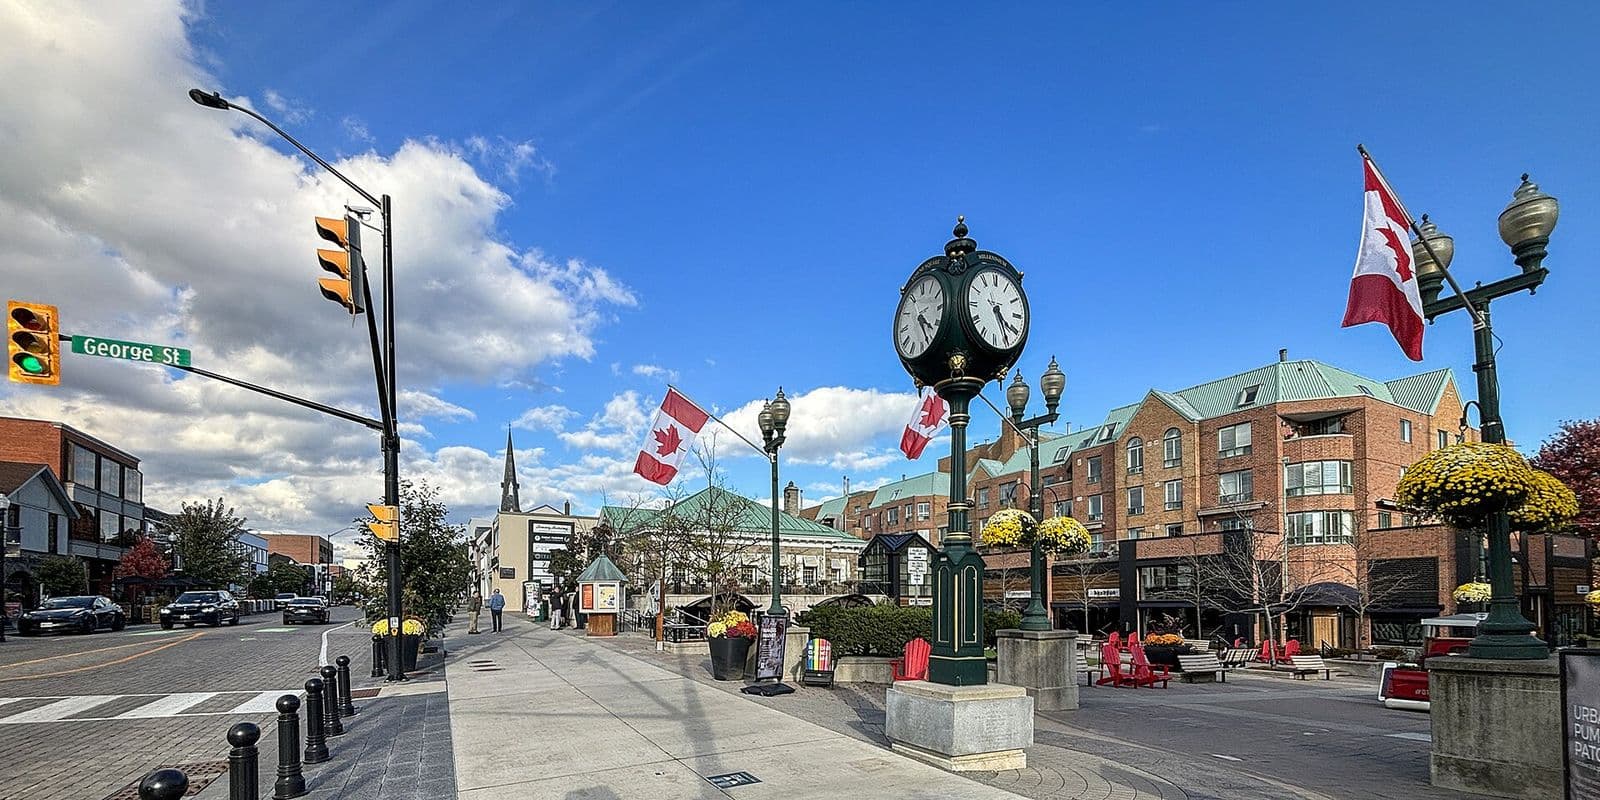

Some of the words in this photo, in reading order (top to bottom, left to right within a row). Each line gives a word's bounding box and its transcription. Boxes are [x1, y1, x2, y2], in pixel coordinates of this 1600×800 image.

[84, 338, 153, 361] George
[163, 348, 180, 365] St
[1574, 705, 1600, 725] URB
